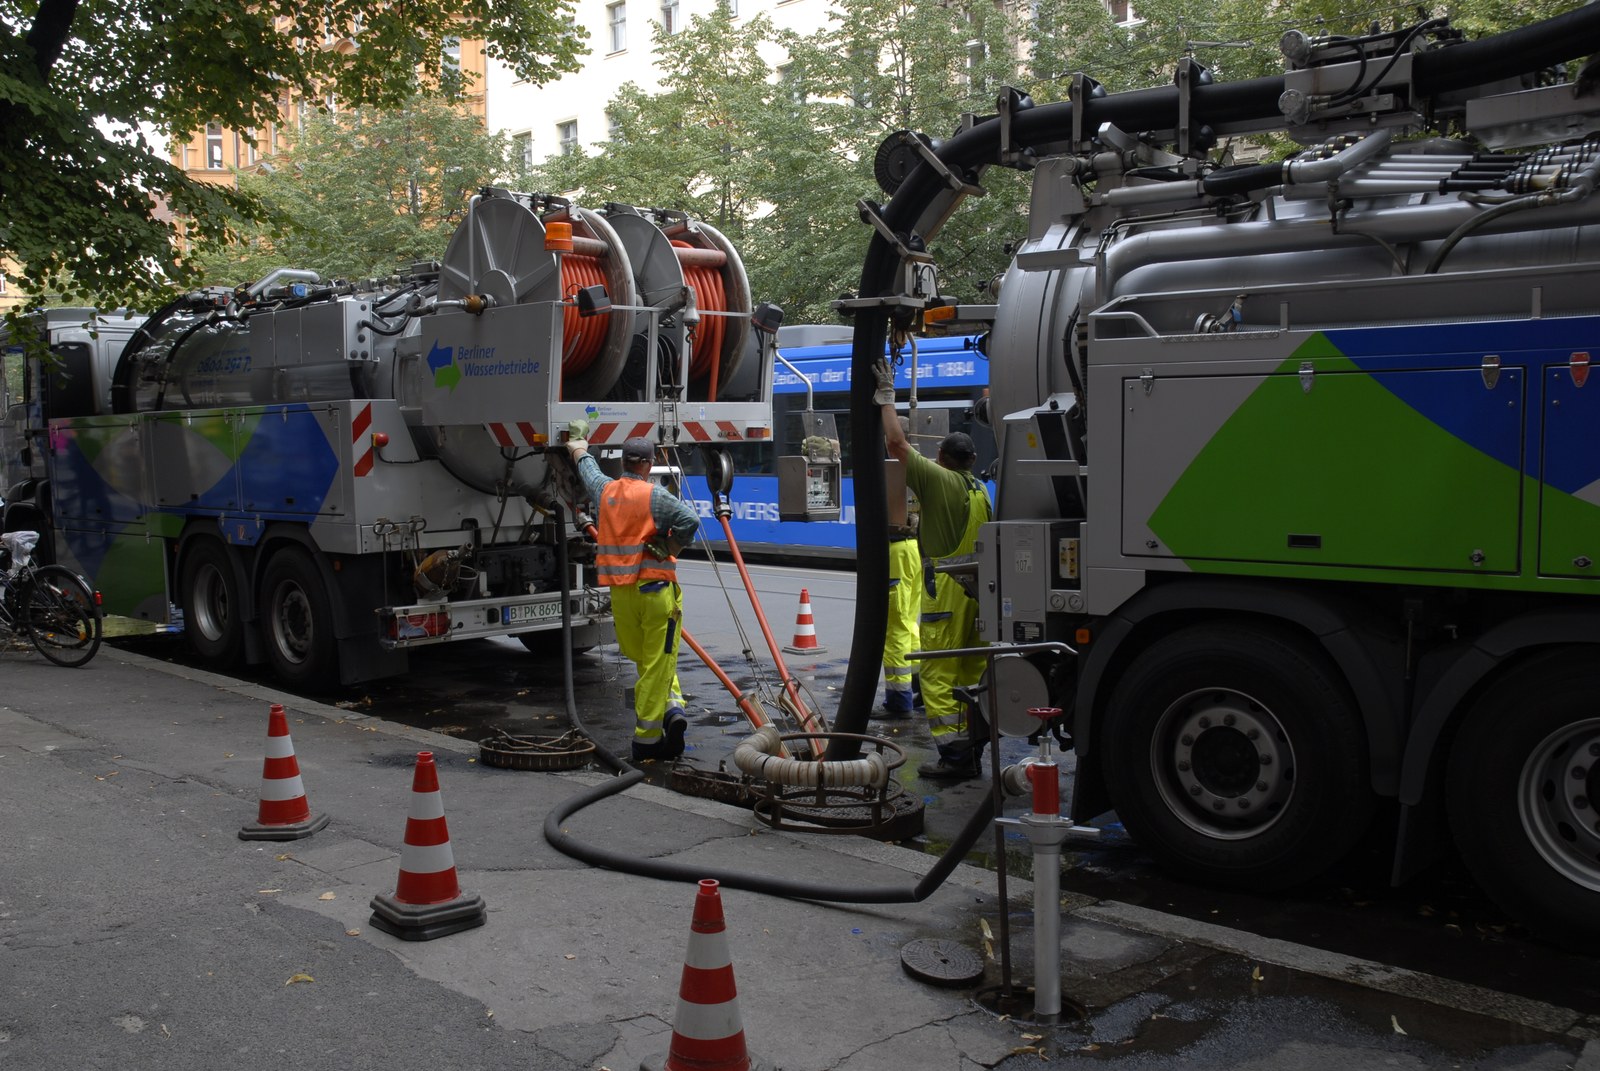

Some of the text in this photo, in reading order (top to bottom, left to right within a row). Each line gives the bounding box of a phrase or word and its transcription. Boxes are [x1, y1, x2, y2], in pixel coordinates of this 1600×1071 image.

[457, 344, 496, 360] Berliner
[465, 357, 540, 376] Wasserbetriebe
[821, 369, 846, 383] der
[904, 363, 934, 378] seit
[1016, 559, 1027, 571] 107
[511, 607, 517, 620] B
[525, 606, 537, 618] PK
